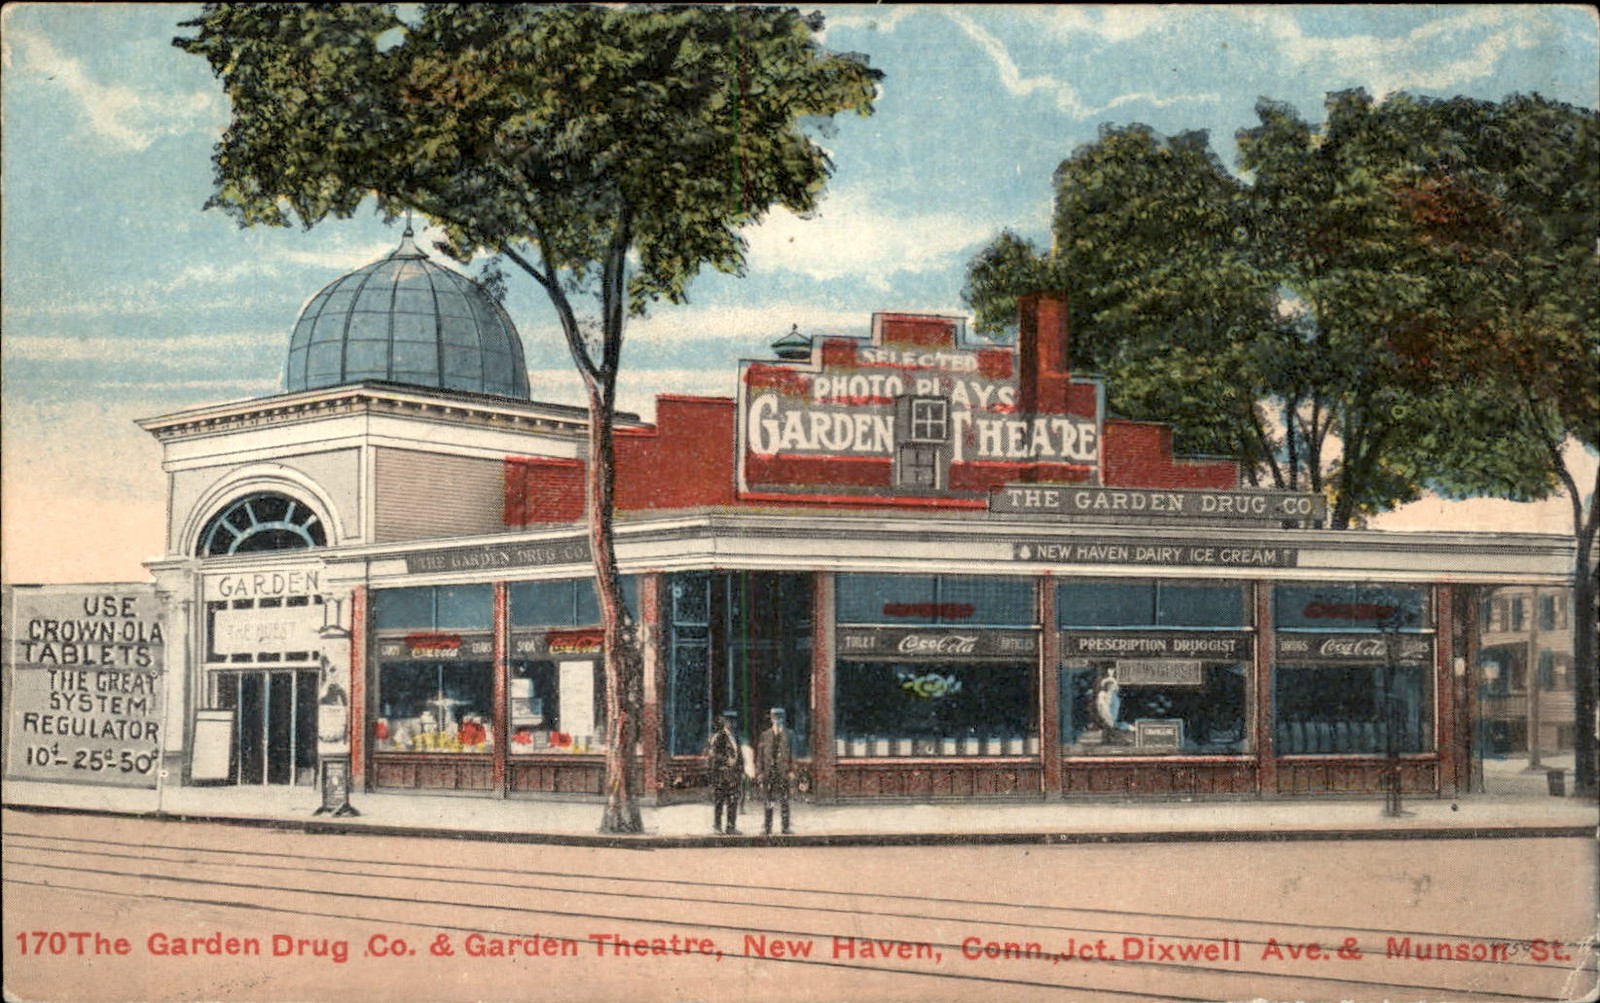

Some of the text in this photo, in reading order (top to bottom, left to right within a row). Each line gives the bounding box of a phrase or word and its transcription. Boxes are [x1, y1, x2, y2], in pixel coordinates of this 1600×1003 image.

[861, 351, 978, 371] SELECTED
[814, 374, 903, 402] PHOTO
[750, 392, 895, 455] GARDEN
[1008, 489, 1060, 508] THE
[1074, 491, 1185, 512] GARDEN
[1201, 494, 1268, 515] DRUG
[517, 547, 556, 563] DRUG
[1036, 545, 1277, 564] NEW HAVEN DAIRY ICE CREAM
[219, 571, 319, 597] GARDEN
[83, 596, 137, 618] USE
[20, 641, 152, 667] TABLETS
[1079, 638, 1237, 652] PRESCRIPTION DRUGGIST
[47, 669, 159, 696] THE GREAT
[50, 691, 148, 717] SYSTEM
[24, 711, 160, 744] REGULATOR
